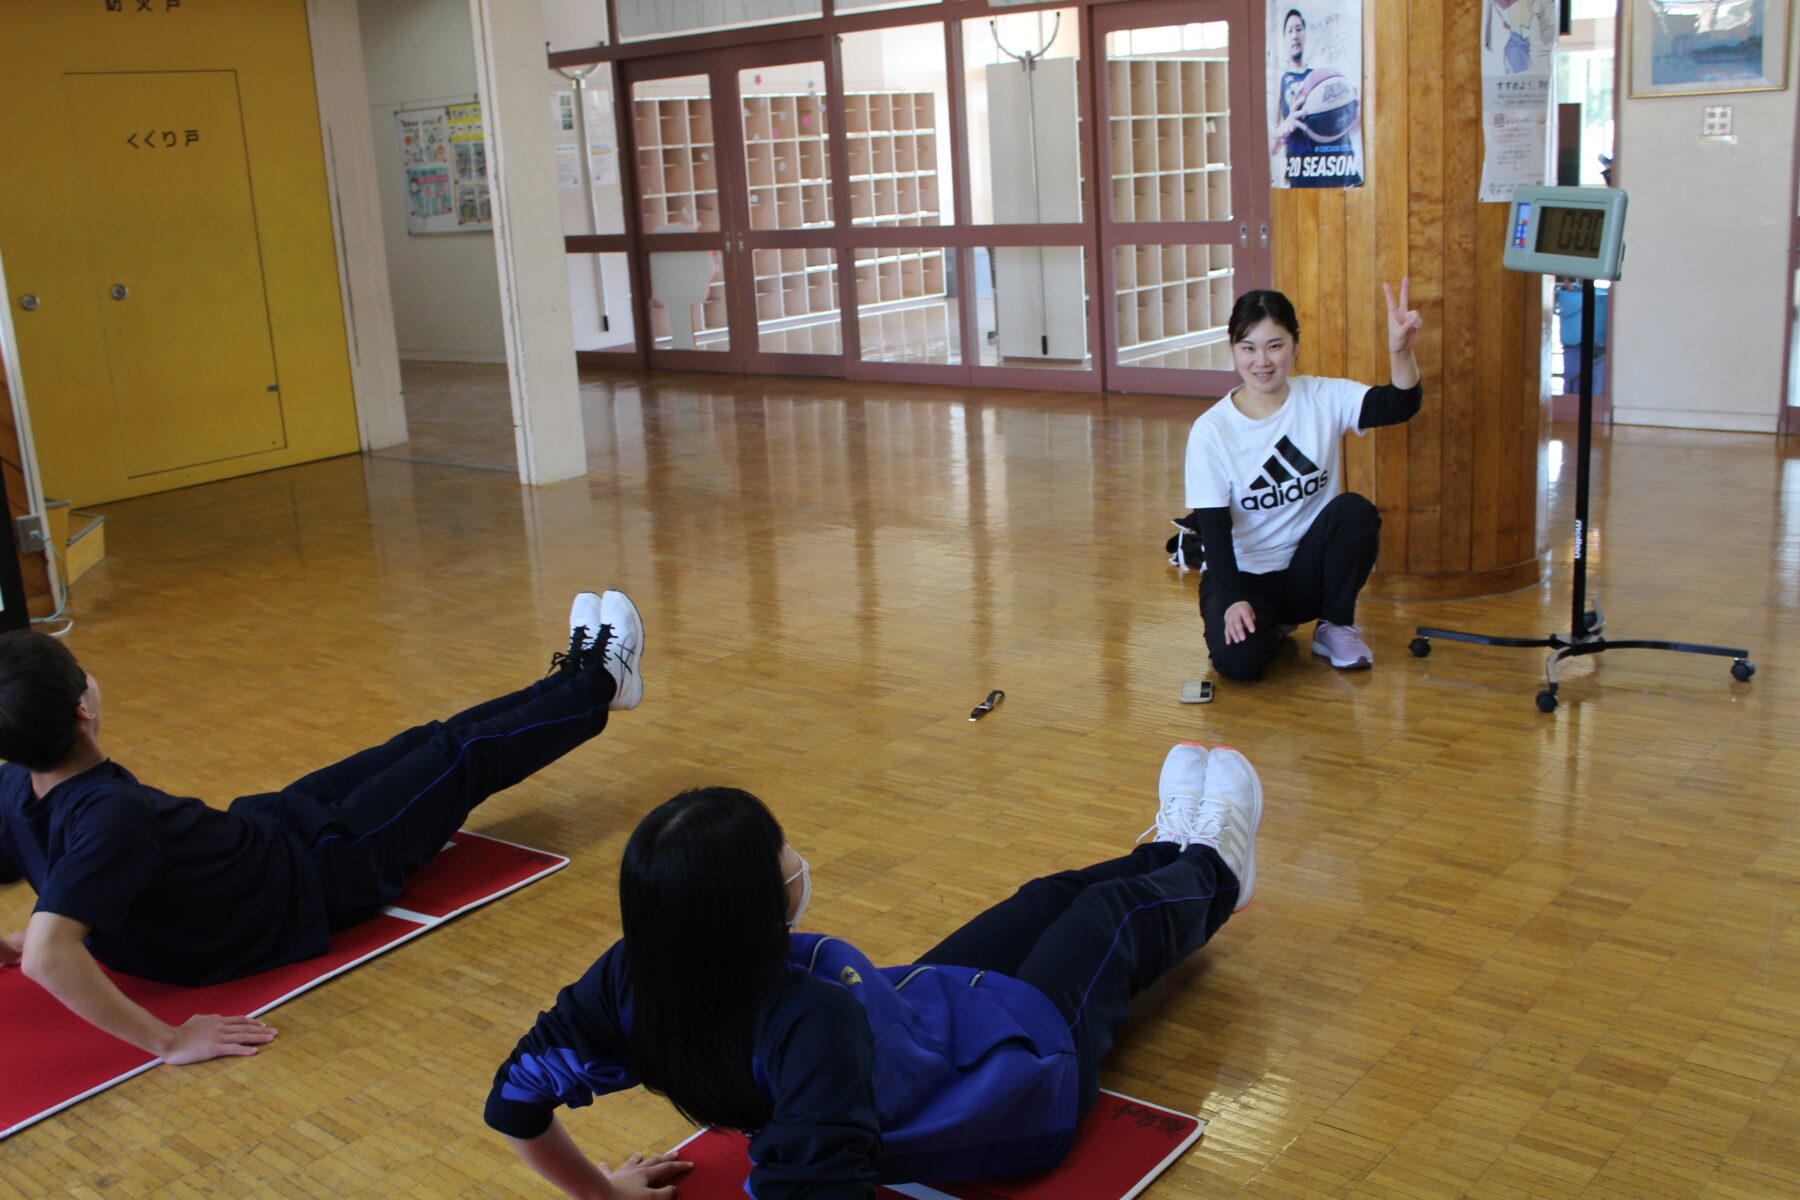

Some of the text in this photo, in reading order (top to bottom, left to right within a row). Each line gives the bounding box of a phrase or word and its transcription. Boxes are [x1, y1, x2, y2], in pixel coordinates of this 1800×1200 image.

[127, 129, 199, 149] くくり戸
[1302, 155, 1358, 177] SEASON
[1240, 470, 1328, 511] adidas
[1574, 519, 1582, 559] molten
